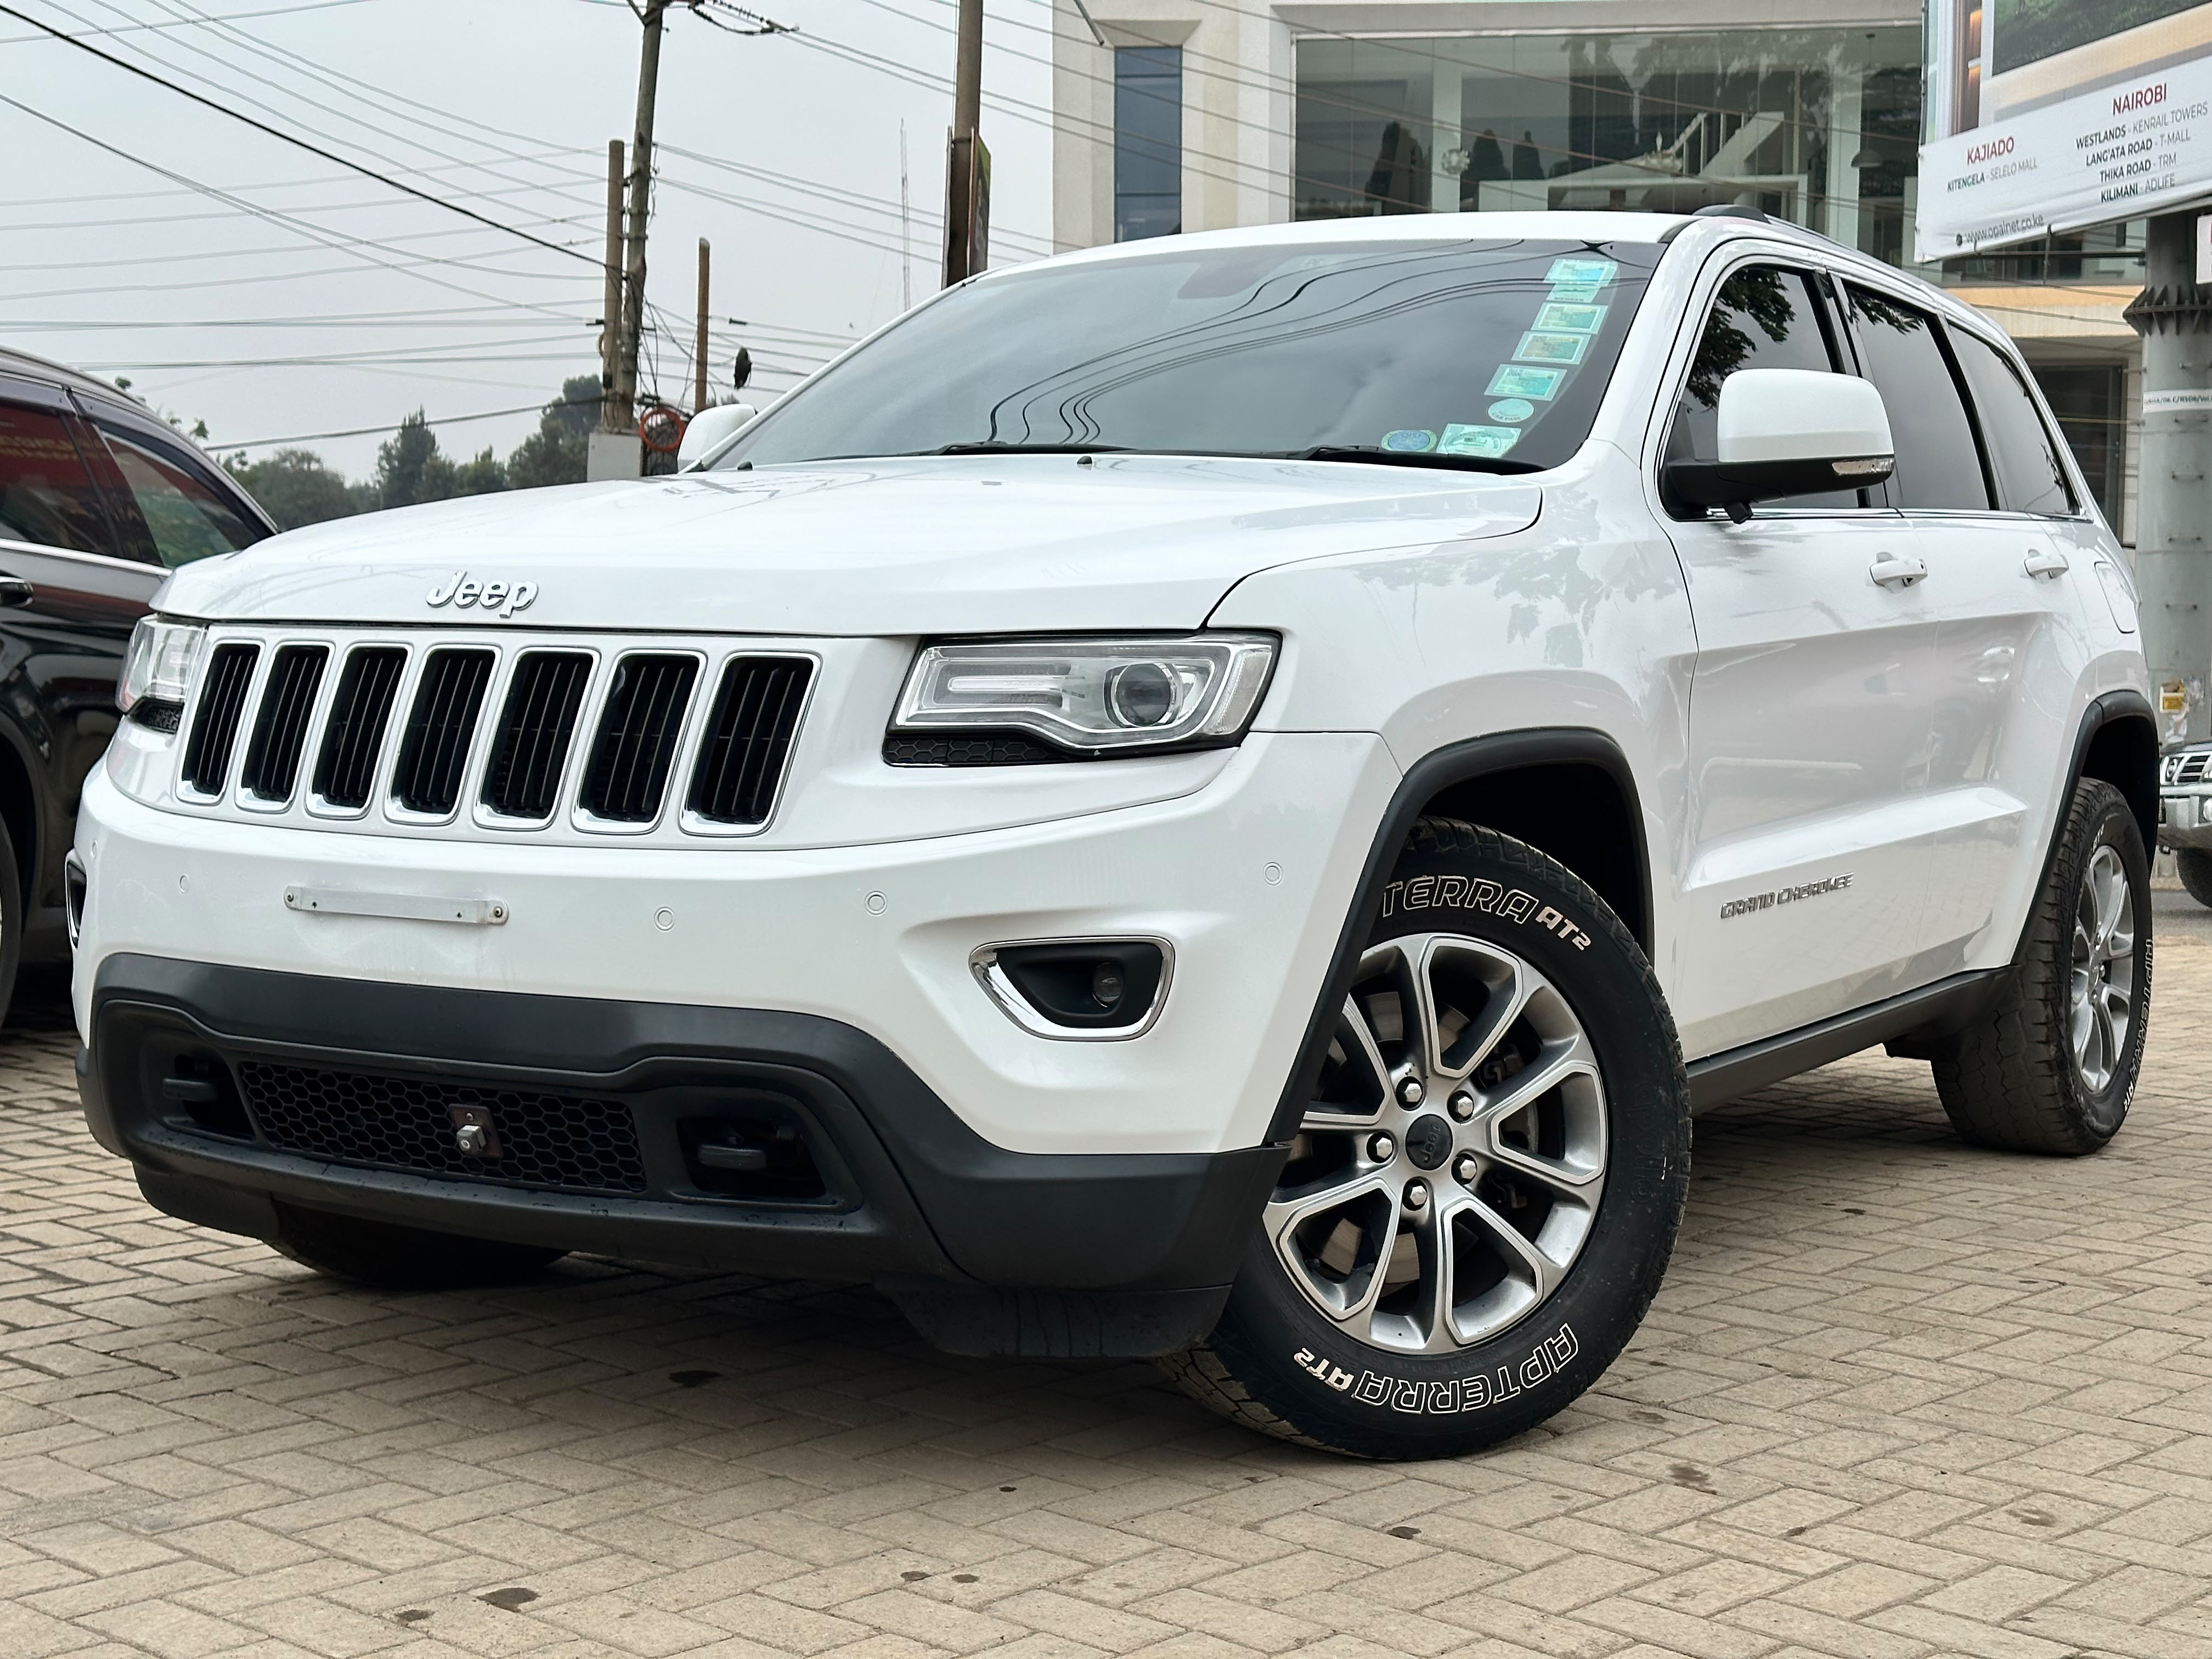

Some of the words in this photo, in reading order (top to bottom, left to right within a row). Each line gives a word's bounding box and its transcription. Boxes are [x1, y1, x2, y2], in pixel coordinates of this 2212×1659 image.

[2113, 83, 2166, 116] NAIROBI
[2075, 125, 2126, 150] WESTLANDS
[2133, 114, 2168, 134] KENRAIL
[2170, 101, 2208, 123] TOWERS
[1967, 136, 2015, 165] KAJIADO
[2086, 145, 2125, 166] LANG'ATA
[2128, 138, 2153, 156] ROAD
[2159, 128, 2191, 148] T-MALL
[2100, 166, 2124, 183] THIKA
[2126, 159, 2151, 176] ROAD
[2158, 152, 2177, 168] TRM
[1948, 172, 1985, 193] KITENGELA
[1990, 162, 2017, 181] SELELO
[2018, 157, 2038, 173] MALL
[2101, 182, 2138, 204] KILIMANI
[2145, 173, 2175, 192] ADLIFE
[426, 570, 539, 618] Jeep
[1720, 891, 1775, 919] GRAND
[1777, 872, 1854, 905] CHEROKEE
[1536, 906, 1592, 951] AT2
[1294, 1347, 1355, 1391] AT2
[1351, 1323, 1579, 1414] APTERRA
